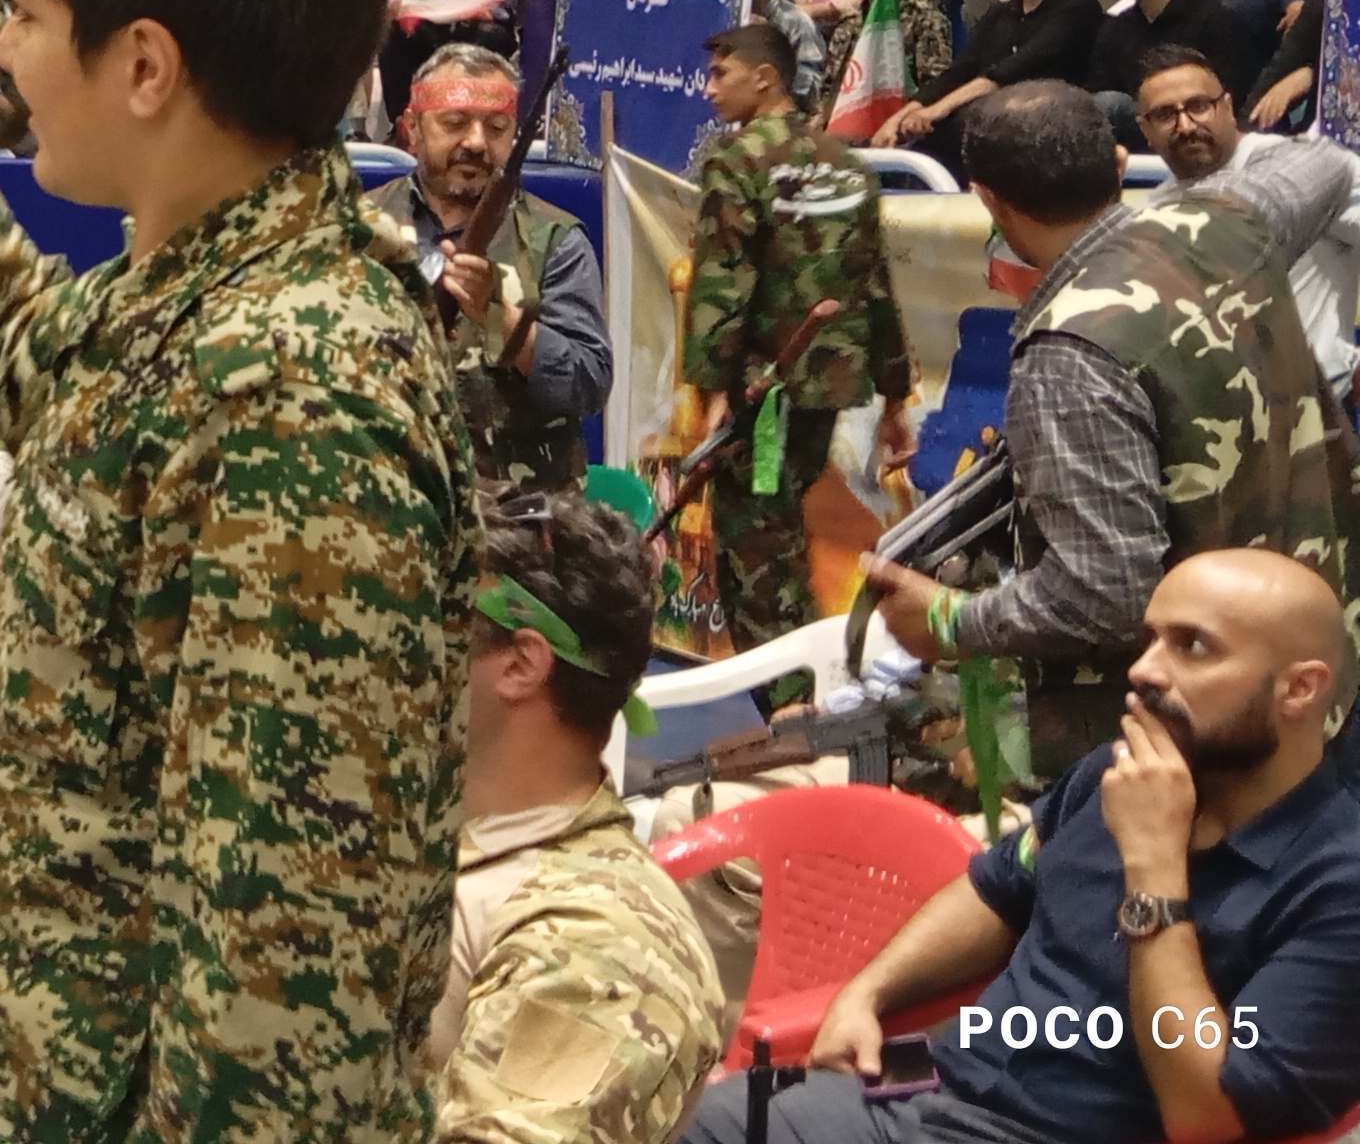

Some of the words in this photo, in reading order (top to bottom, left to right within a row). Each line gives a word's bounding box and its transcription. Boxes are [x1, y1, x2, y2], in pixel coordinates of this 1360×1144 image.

[601, 57, 635, 87] ابراهیم
[634, 63, 655, 88] سید
[656, 65, 684, 92] شهید
